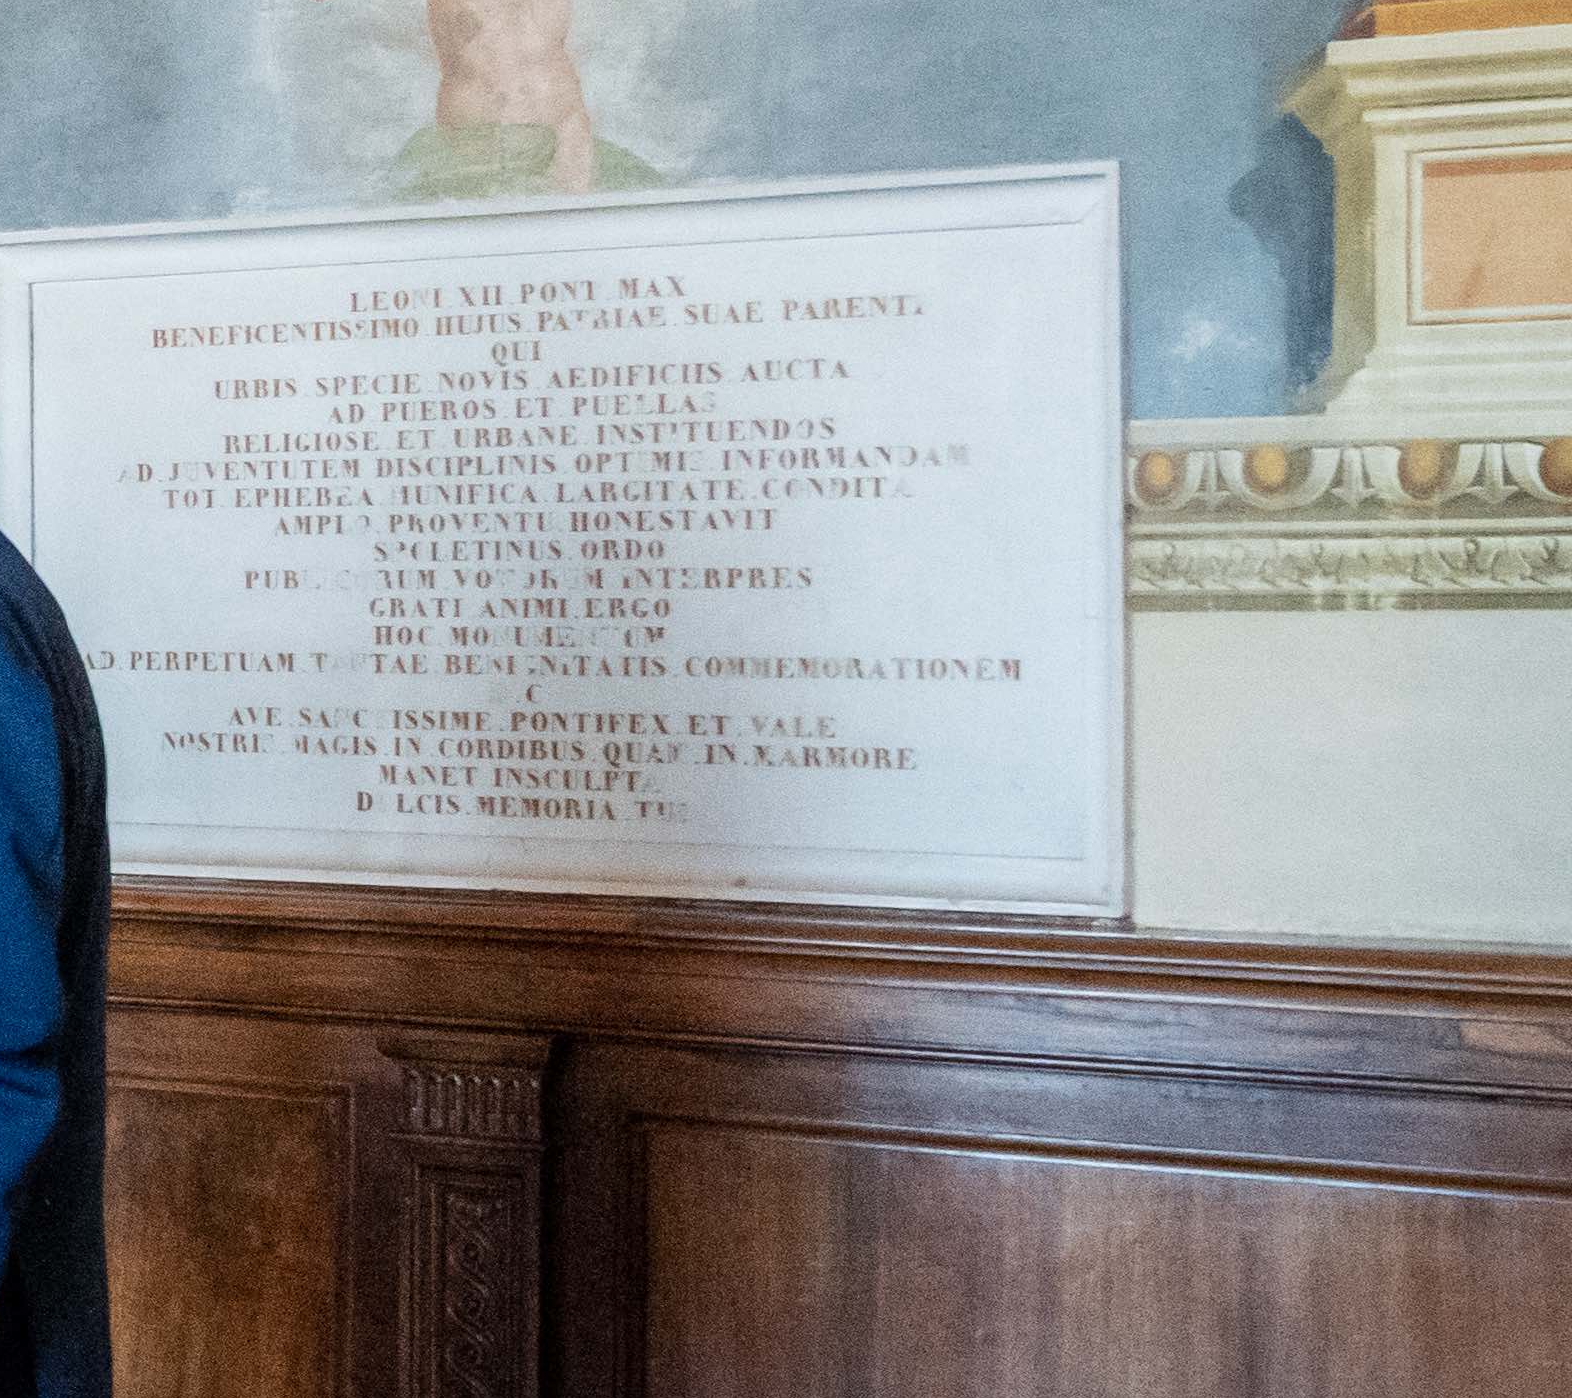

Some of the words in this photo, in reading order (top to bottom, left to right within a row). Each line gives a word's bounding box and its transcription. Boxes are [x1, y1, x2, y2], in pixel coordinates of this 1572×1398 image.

[458, 285, 503, 308] XII
[617, 275, 686, 300] MAX
[684, 300, 764, 325] SUAE
[782, 295, 926, 322] PARENT
[491, 340, 542, 366] QUI
[214, 377, 297, 400] URBIS
[315, 373, 420, 397] SPECIE
[439, 369, 528, 392] NOVIS
[741, 358, 850, 382] AUCTA
[329, 403, 364, 424] AD
[381, 398, 496, 422] PUEROS
[515, 397, 554, 419] ET
[224, 431, 379, 454] RELIGIOSE
[397, 429, 434, 450] ET
[454, 425, 578, 448] URBANE
[118, 462, 154, 483] D
[376, 454, 557, 478] DISCIPLINIS
[164, 489, 216, 509] TOT
[556, 479, 744, 504] LARGITATE
[570, 508, 778, 533] HONESTAVIT
[581, 539, 666, 561] ORDO
[369, 598, 464, 619] GRATI
[482, 597, 568, 619] ANIMI
[584, 597, 672, 620] ERGO
[373, 626, 434, 647] HOC
[130, 651, 295, 673] PERPETUAM
[229, 707, 282, 728] AVE
[510, 710, 670, 735] PONTIFEX
[688, 714, 733, 736] ET
[750, 715, 837, 738] VALE
[394, 737, 422, 756] IN
[438, 738, 586, 763] CORDIBUS
[704, 743, 738, 765] IN
[379, 764, 479, 786] MANET
[356, 791, 462, 815] DLCIS
[476, 795, 617, 821] MEMORIA
